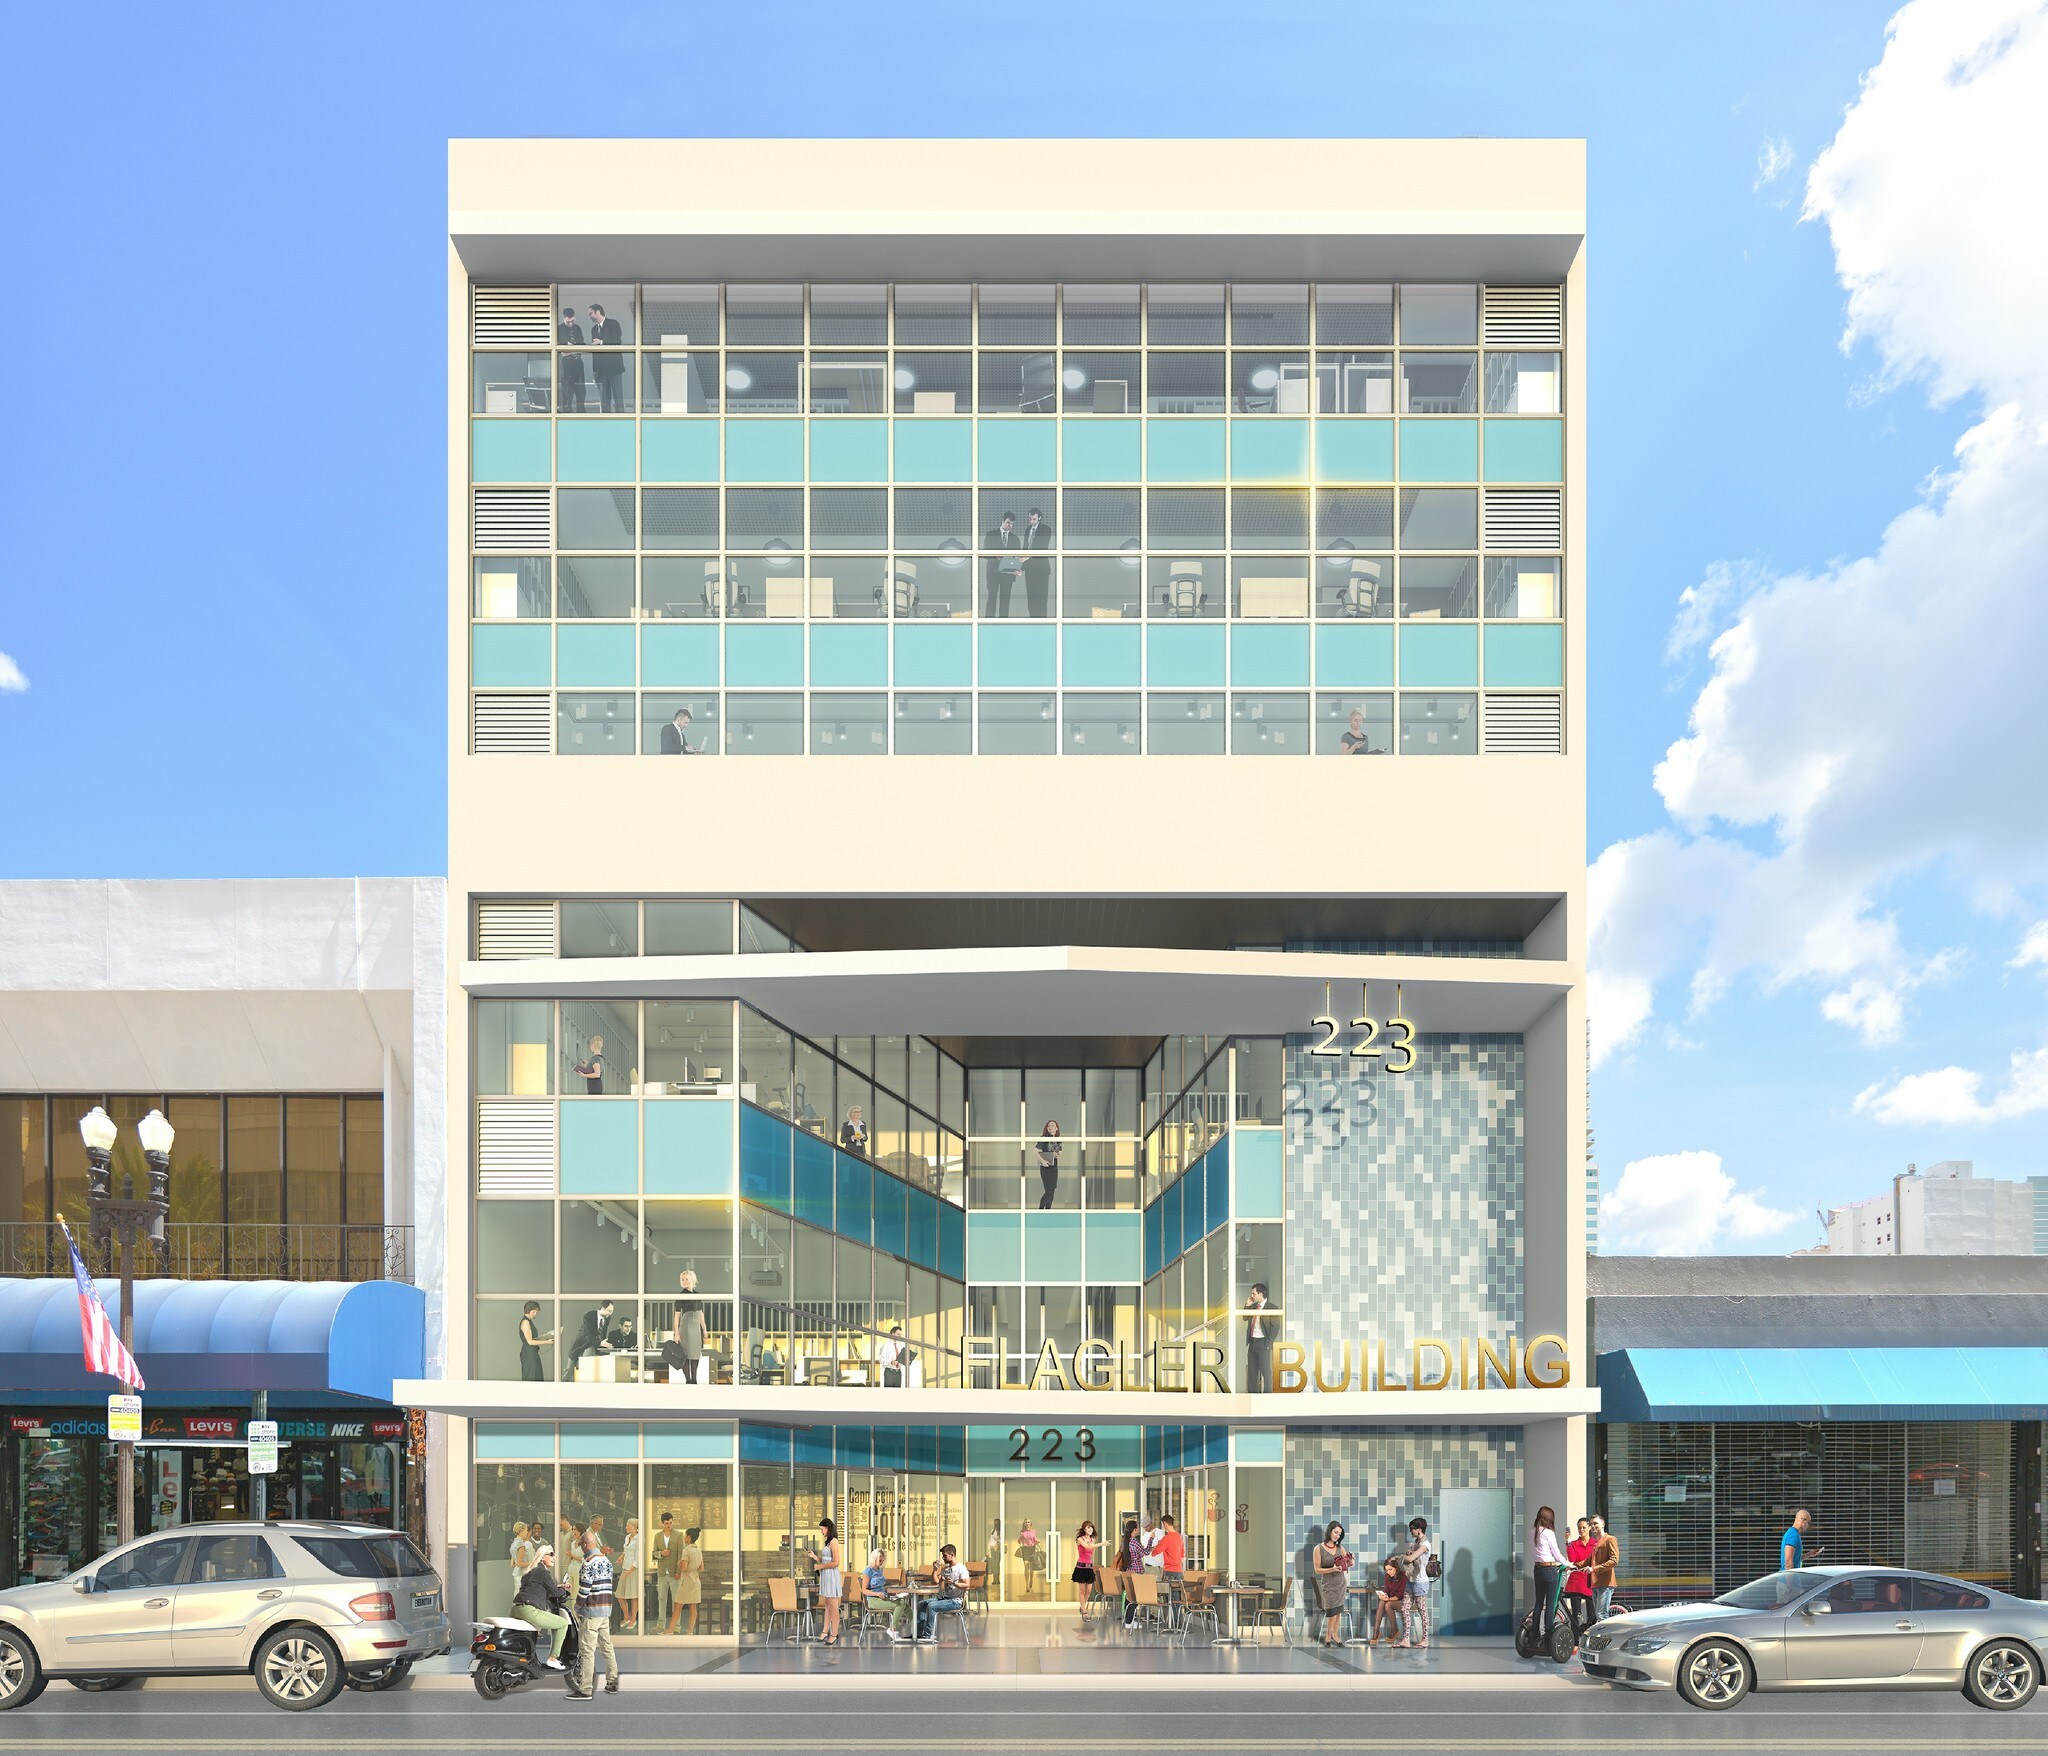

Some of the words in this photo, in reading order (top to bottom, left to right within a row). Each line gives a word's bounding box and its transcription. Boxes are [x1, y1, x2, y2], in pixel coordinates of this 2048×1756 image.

[1311, 1015, 1418, 1074] 223
[961, 1336, 1232, 1394] FLAGLER
[1272, 1334, 1570, 1393] BUILDING
[50, 1420, 107, 1435] adidas
[330, 1423, 365, 1437] NIKE
[1008, 1428, 1096, 1462] 223
